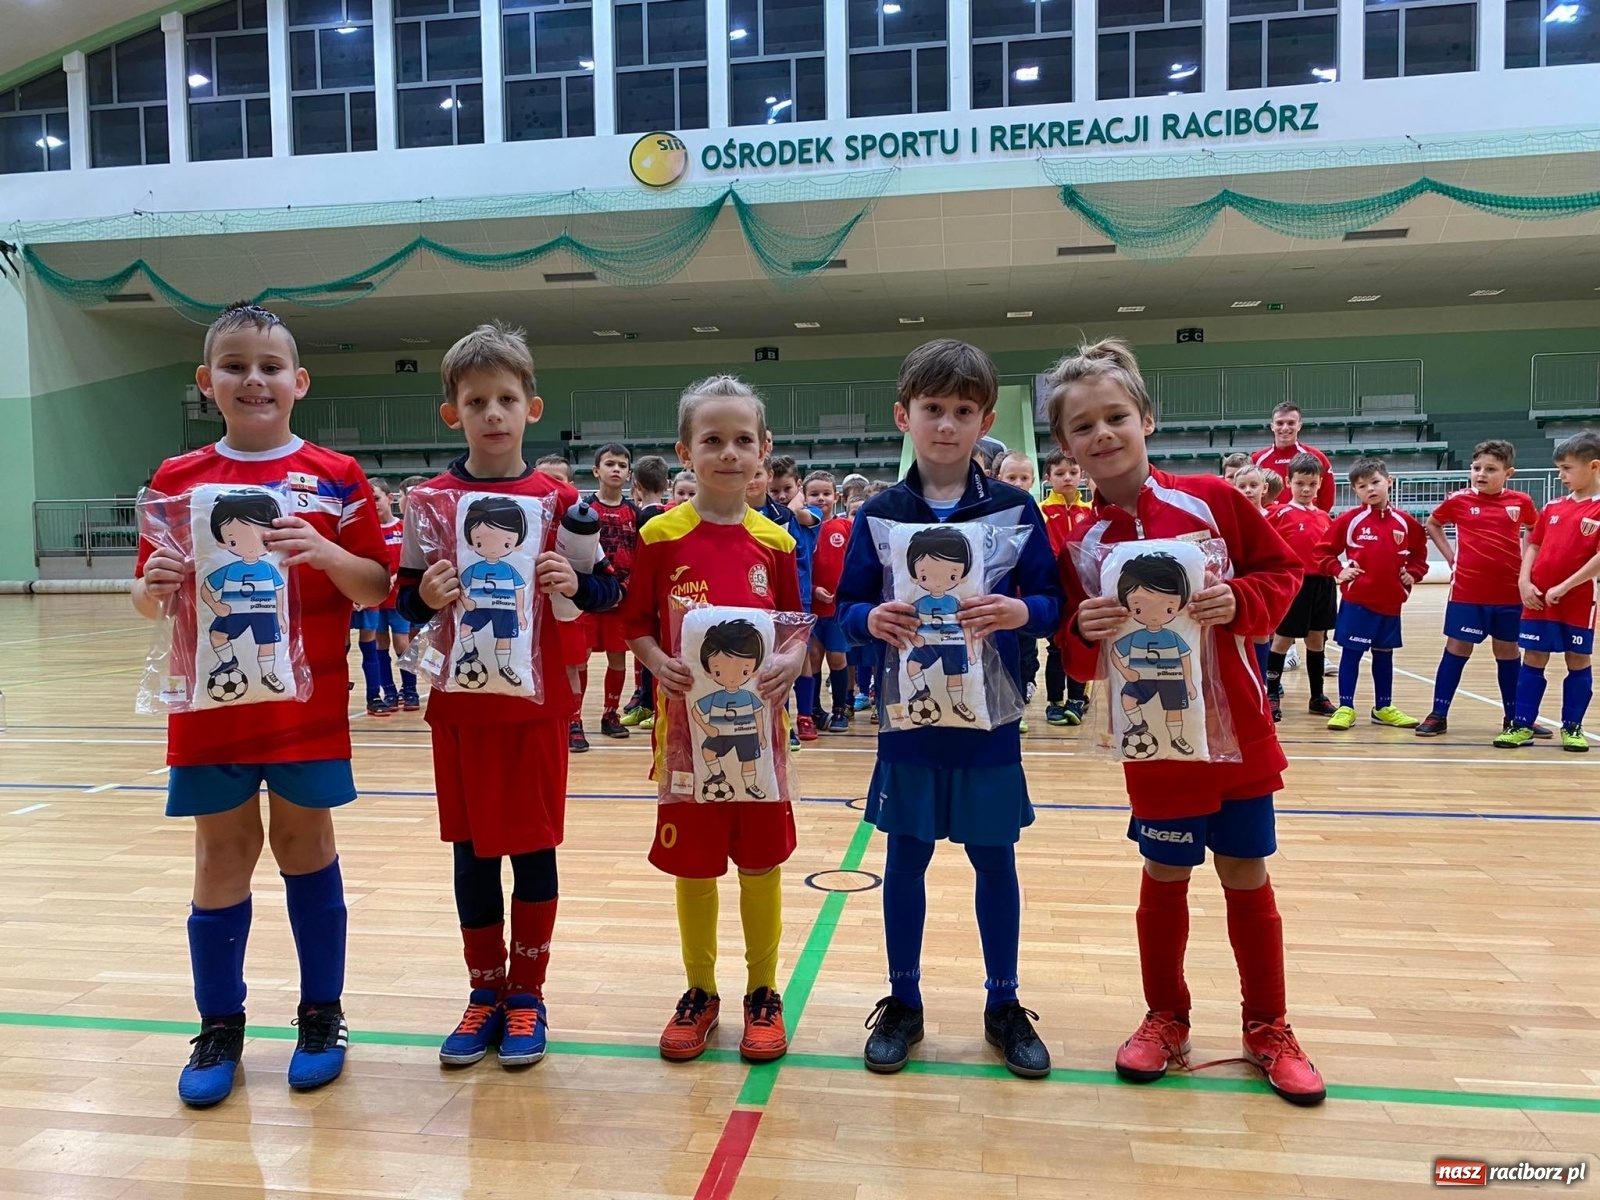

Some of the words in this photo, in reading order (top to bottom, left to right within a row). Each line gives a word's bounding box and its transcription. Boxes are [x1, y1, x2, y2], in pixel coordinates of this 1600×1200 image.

[701, 137, 833, 170] OŚRODEK
[845, 128, 959, 161] SPORTU
[971, 127, 978, 153] I
[990, 115, 1149, 151] REKREACJI
[1162, 101, 1319, 140] RACIBÓRZ
[403, 363, 414, 371] A
[297, 493, 309, 508] S
[1469, 506, 1481, 515] 19
[1361, 526, 1371, 536] 14
[239, 574, 256, 598] 5
[483, 573, 497, 595] 5
[670, 580, 709, 597] GMINA
[931, 607, 944, 630] 5
[1571, 635, 1583, 645] 20
[1145, 642, 1160, 665] 5
[724, 701, 737, 722] 5
[1141, 825, 1194, 844] LEGEA
